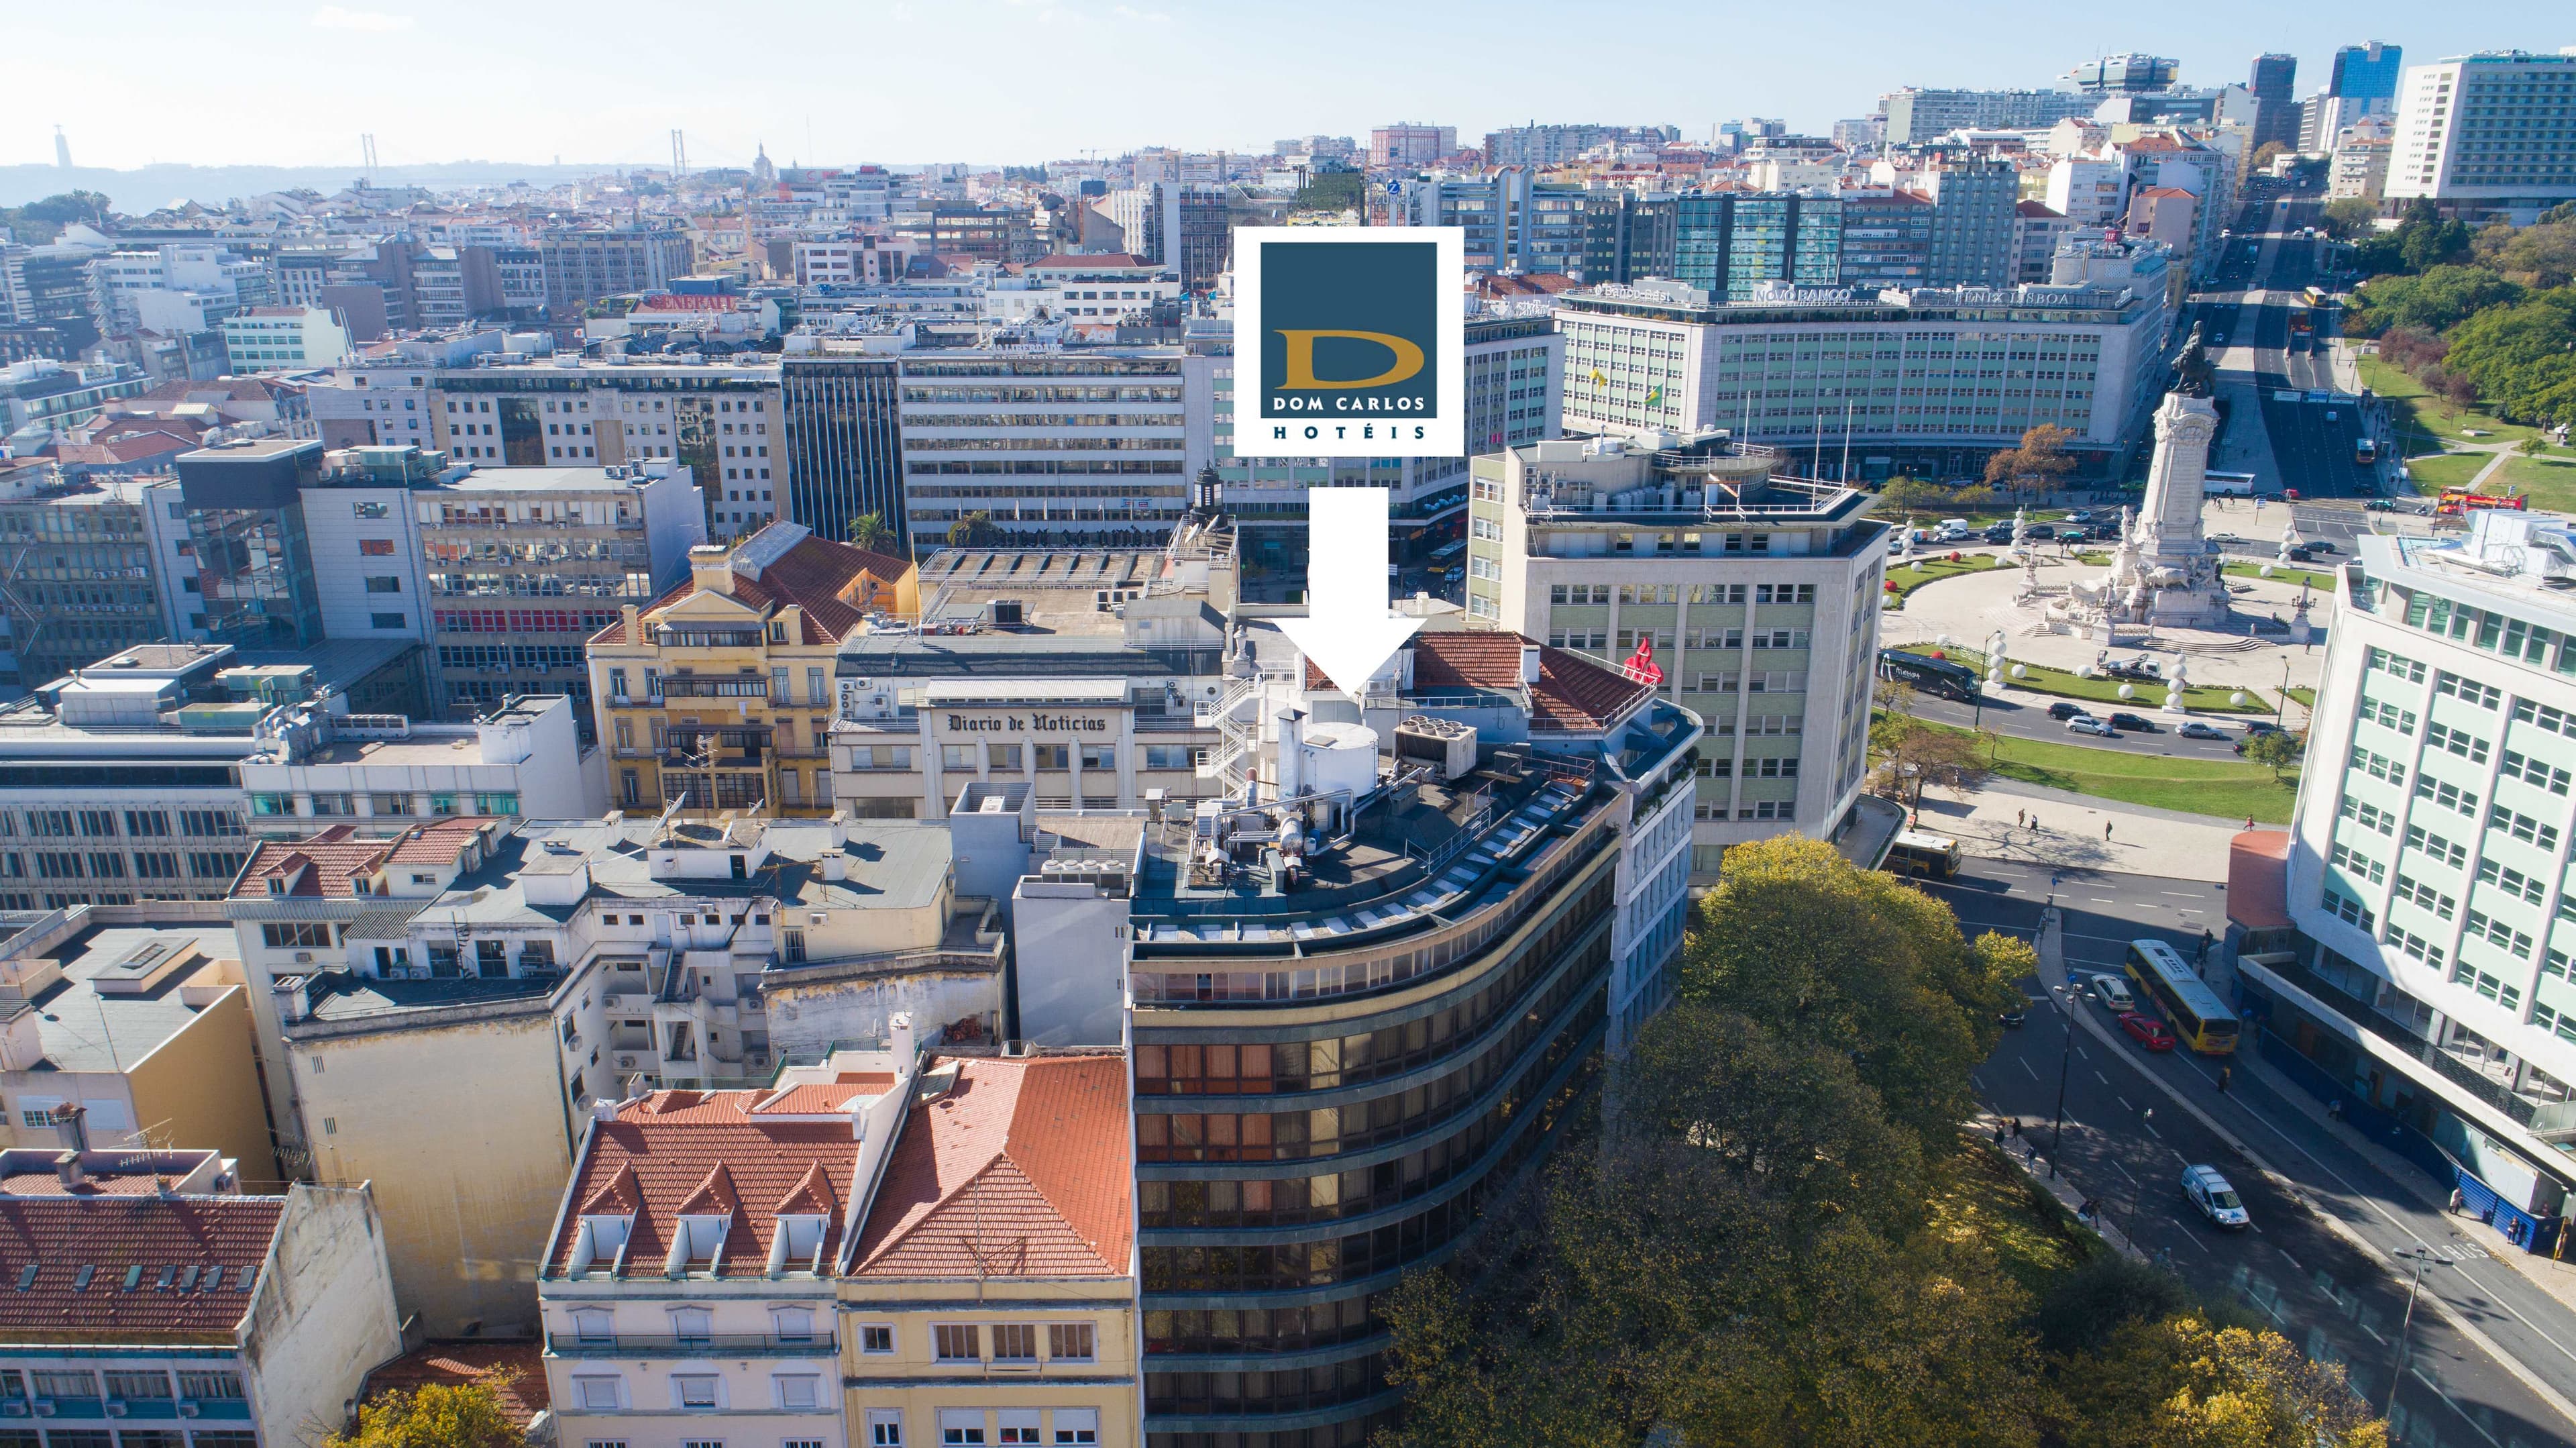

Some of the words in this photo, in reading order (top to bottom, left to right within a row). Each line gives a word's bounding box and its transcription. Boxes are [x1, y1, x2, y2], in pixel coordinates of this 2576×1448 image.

[1756, 289, 1796, 301] NOVO
[1798, 289, 1851, 301] BANCO
[2010, 292, 2069, 303] LISBOA
[949, 713, 1002, 731] Diario
[1008, 715, 1025, 731] de
[1032, 712, 1106, 731] Noticias
[2442, 1243, 2489, 1260] BUS
